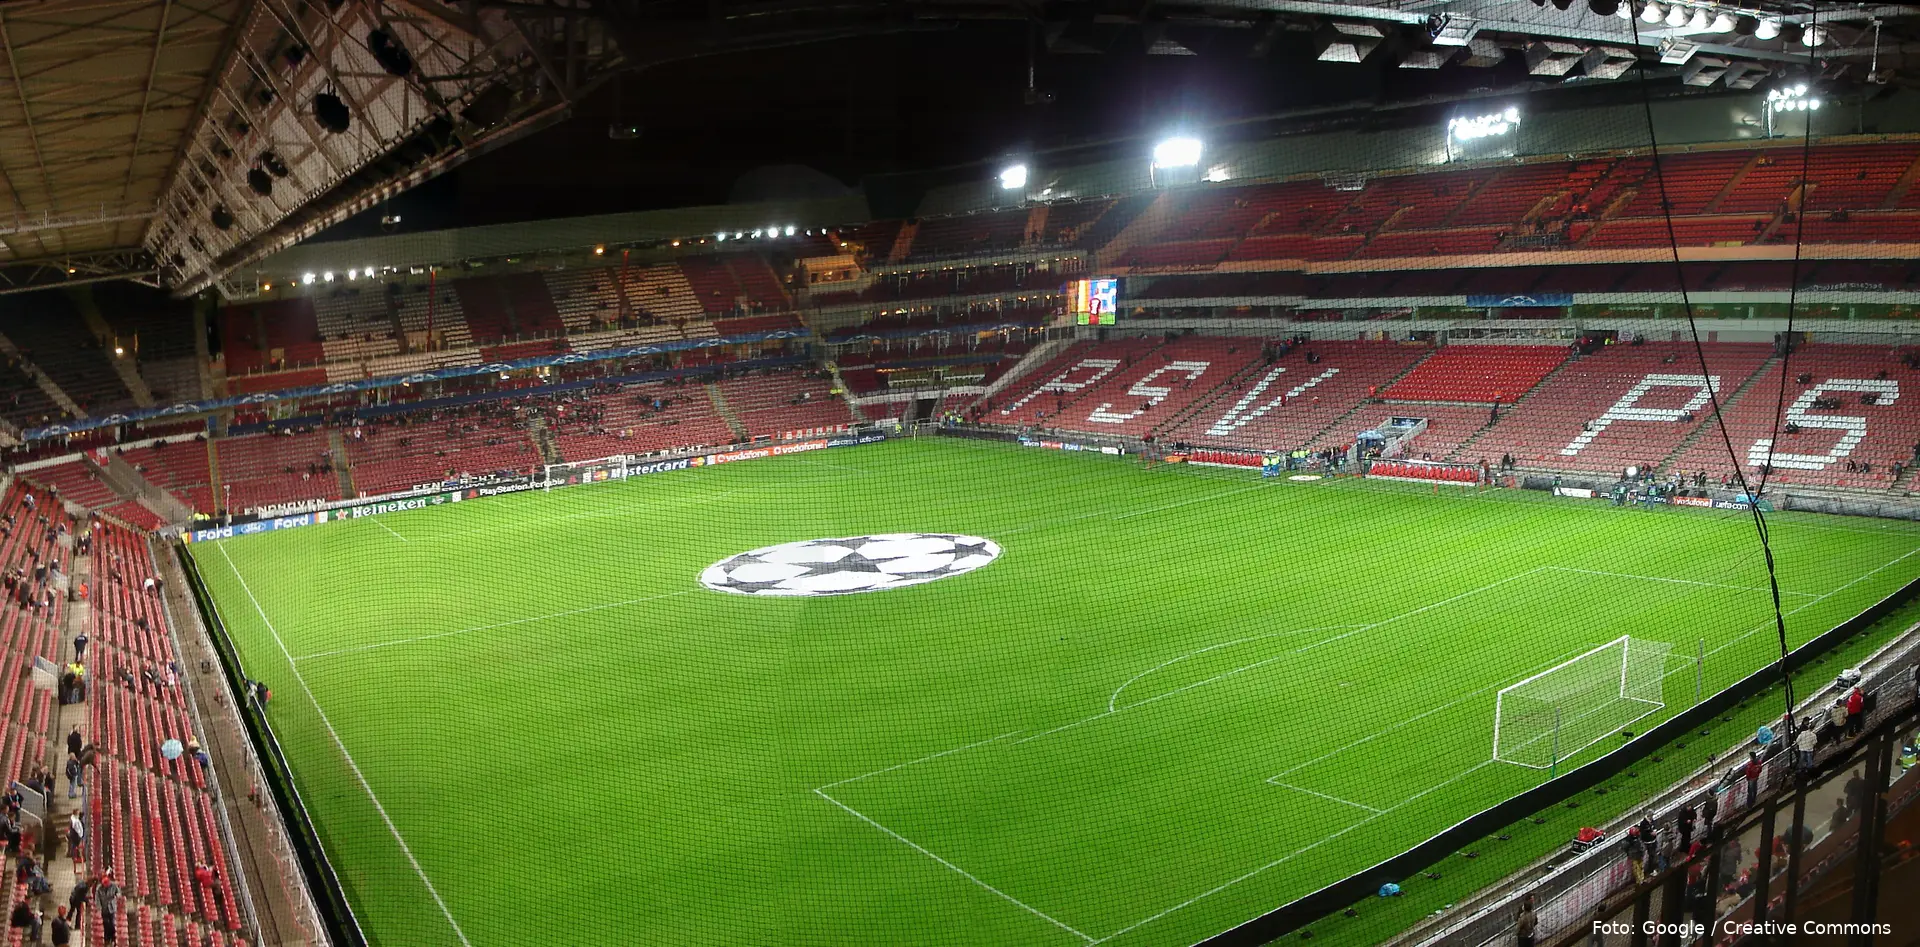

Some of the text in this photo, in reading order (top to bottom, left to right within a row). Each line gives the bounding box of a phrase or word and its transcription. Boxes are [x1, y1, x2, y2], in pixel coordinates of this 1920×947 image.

[782, 441, 824, 455] vodafone
[726, 449, 769, 462] vodafone
[352, 498, 427, 519] Heineken
[1676, 498, 1709, 508] vodafone
[1715, 500, 1749, 511] uefa.com
[273, 514, 309, 530] Ford
[197, 525, 233, 542] Ford
